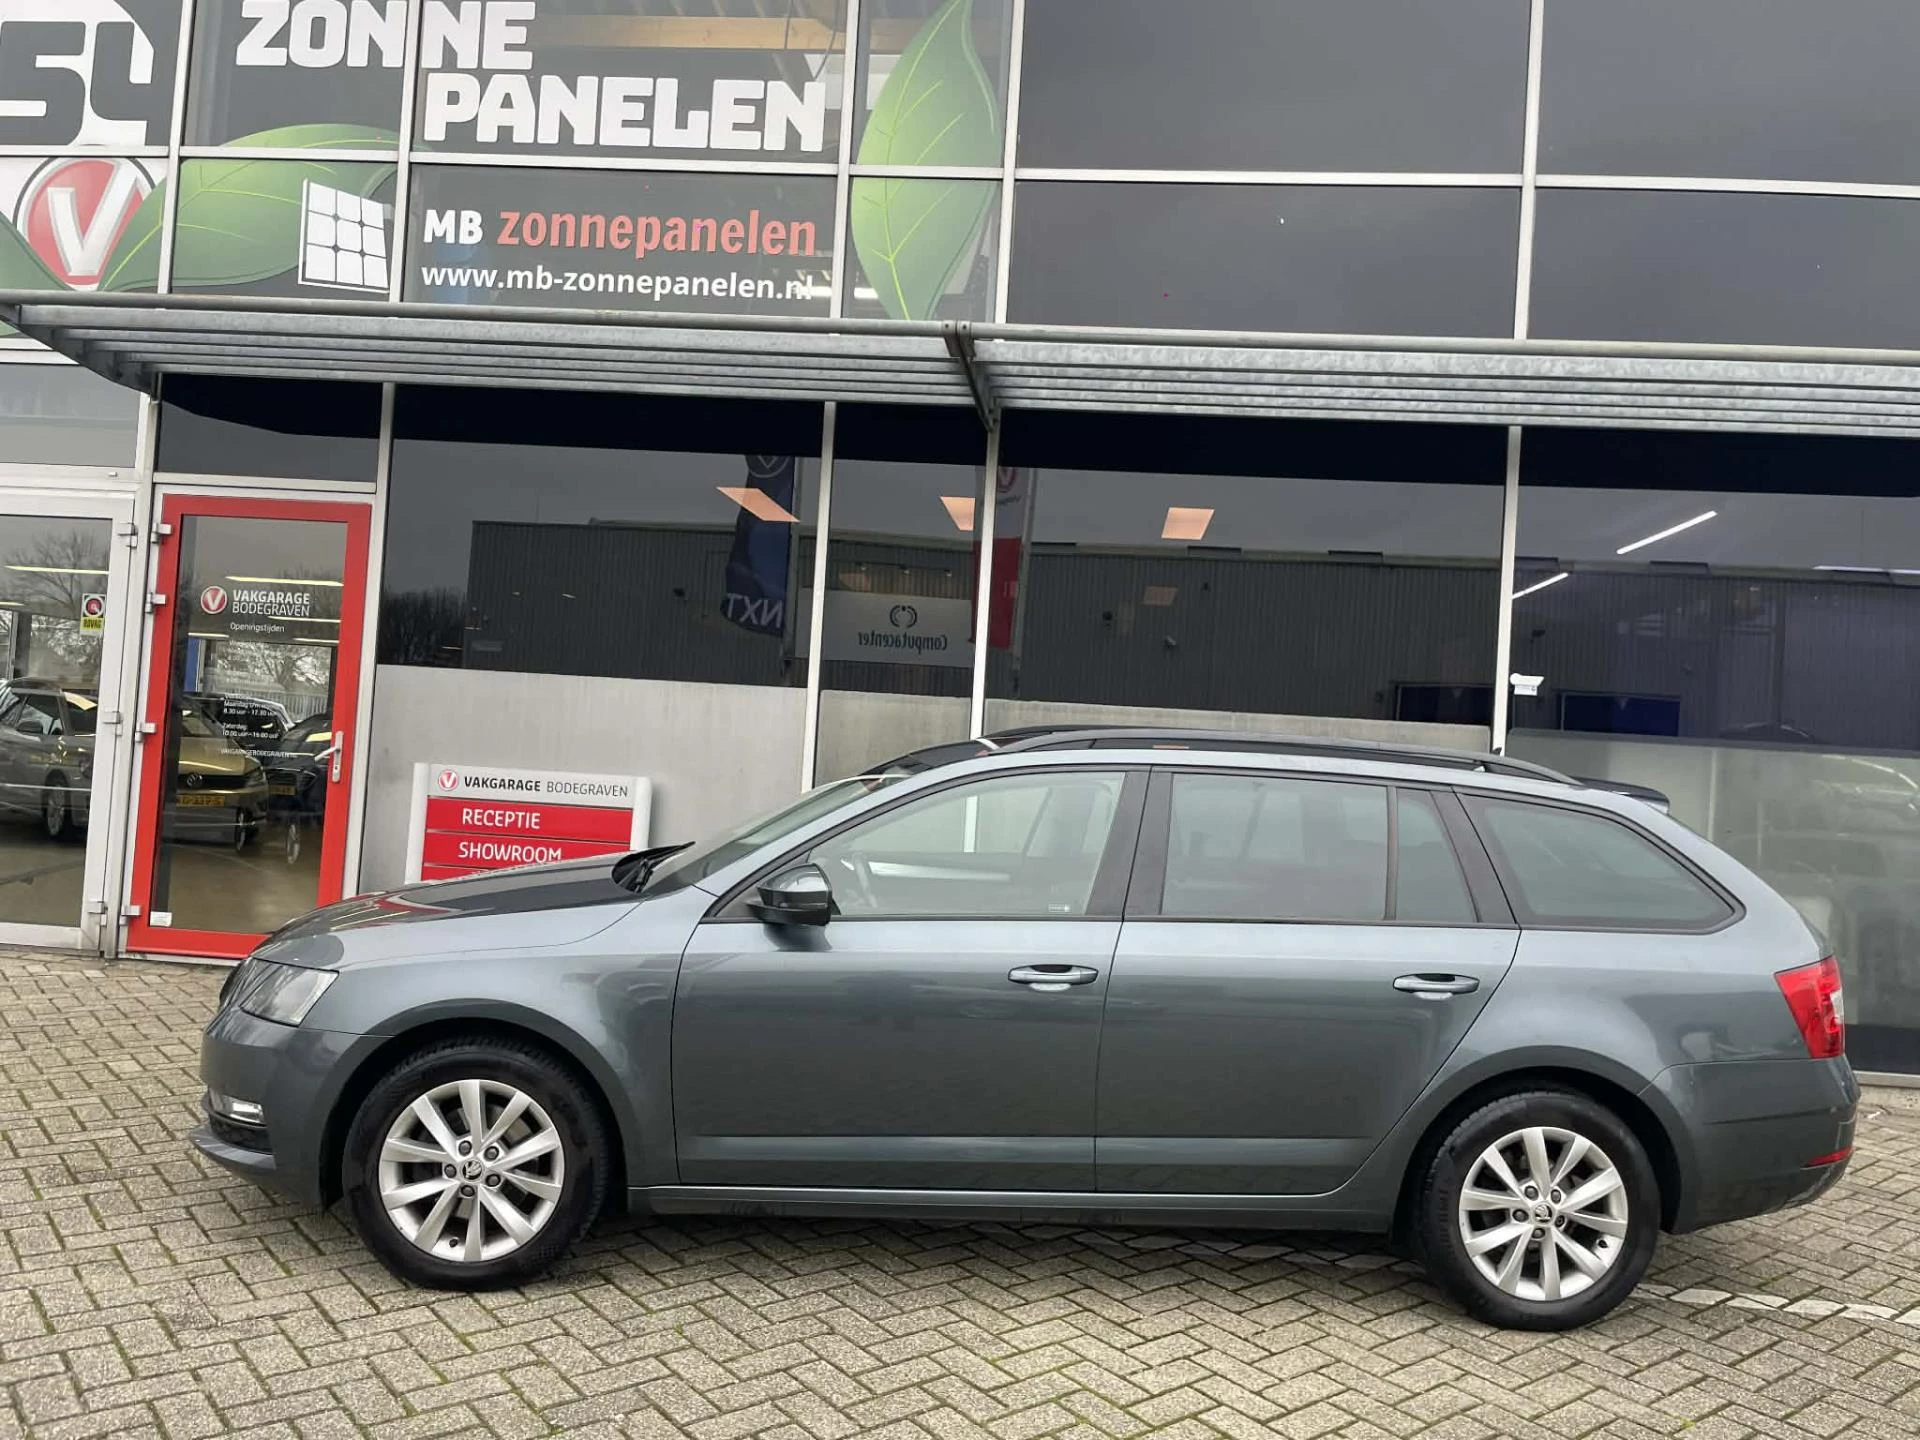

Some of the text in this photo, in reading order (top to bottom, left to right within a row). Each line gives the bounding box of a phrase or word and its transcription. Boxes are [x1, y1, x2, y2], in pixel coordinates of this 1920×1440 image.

[236, 0, 536, 70] ZONNE
[424, 72, 827, 152] PANELEN
[423, 208, 817, 260] MB zonnepanelen
[421, 264, 813, 301] www.mb-zonnepanelen.nl
[232, 589, 310, 605] VAKGARAGE
[232, 602, 310, 616] BODEGRAVEN
[230, 622, 285, 633] Openingstijden
[463, 775, 541, 792] VAKGARAGE
[546, 780, 628, 797] BODEGRAVEN
[462, 808, 541, 830] RECEPTIE
[457, 841, 562, 864] SHOWROOM
